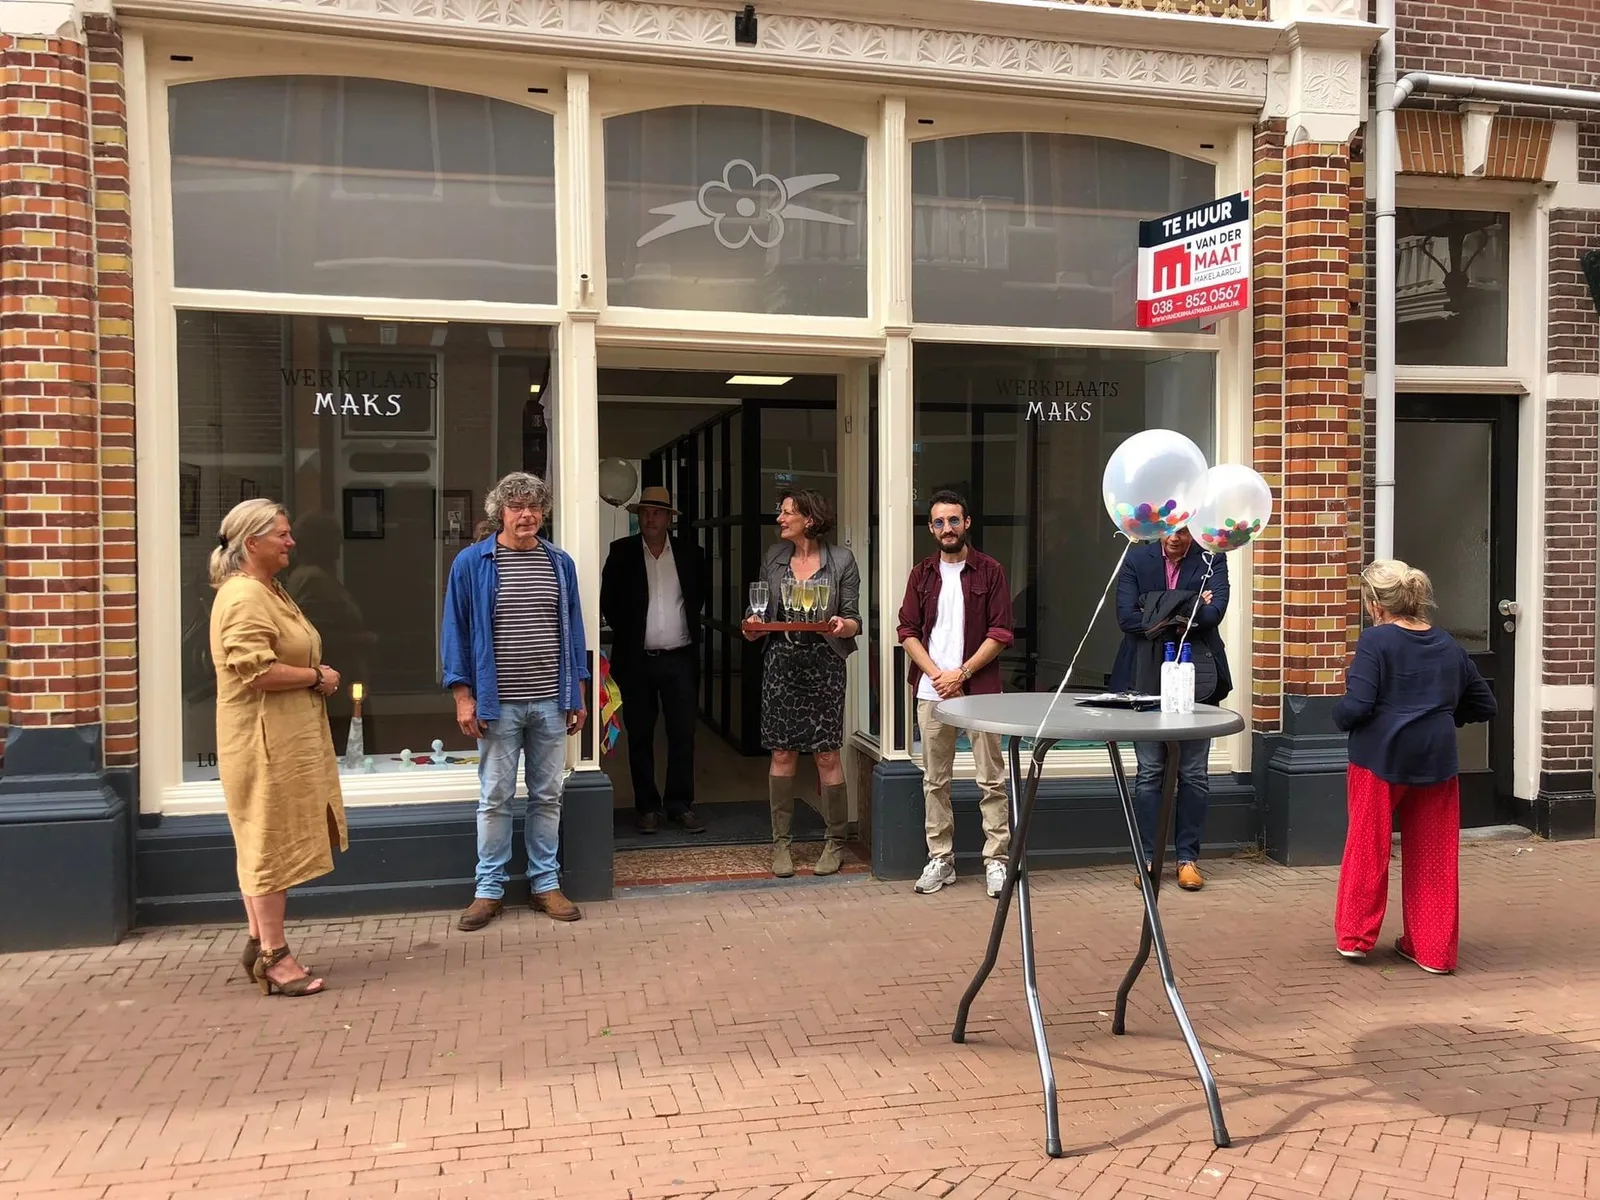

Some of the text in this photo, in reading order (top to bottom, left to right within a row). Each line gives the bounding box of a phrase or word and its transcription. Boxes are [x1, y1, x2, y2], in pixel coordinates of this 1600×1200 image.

[1162, 201, 1232, 238] TE HUUR
[1195, 228, 1242, 250] VAN DER
[1194, 243, 1242, 271] MAAT
[1194, 266, 1242, 283] MAKELAARDIJ
[1151, 299, 1173, 315] 038
[1185, 291, 1207, 309] 852
[1209, 284, 1241, 303] 0567
[280, 368, 439, 390] WERKPLAATS
[996, 379, 1119, 397] WERKPLAATS
[312, 392, 402, 416] MAKS
[1024, 401, 1092, 421] MAKS
